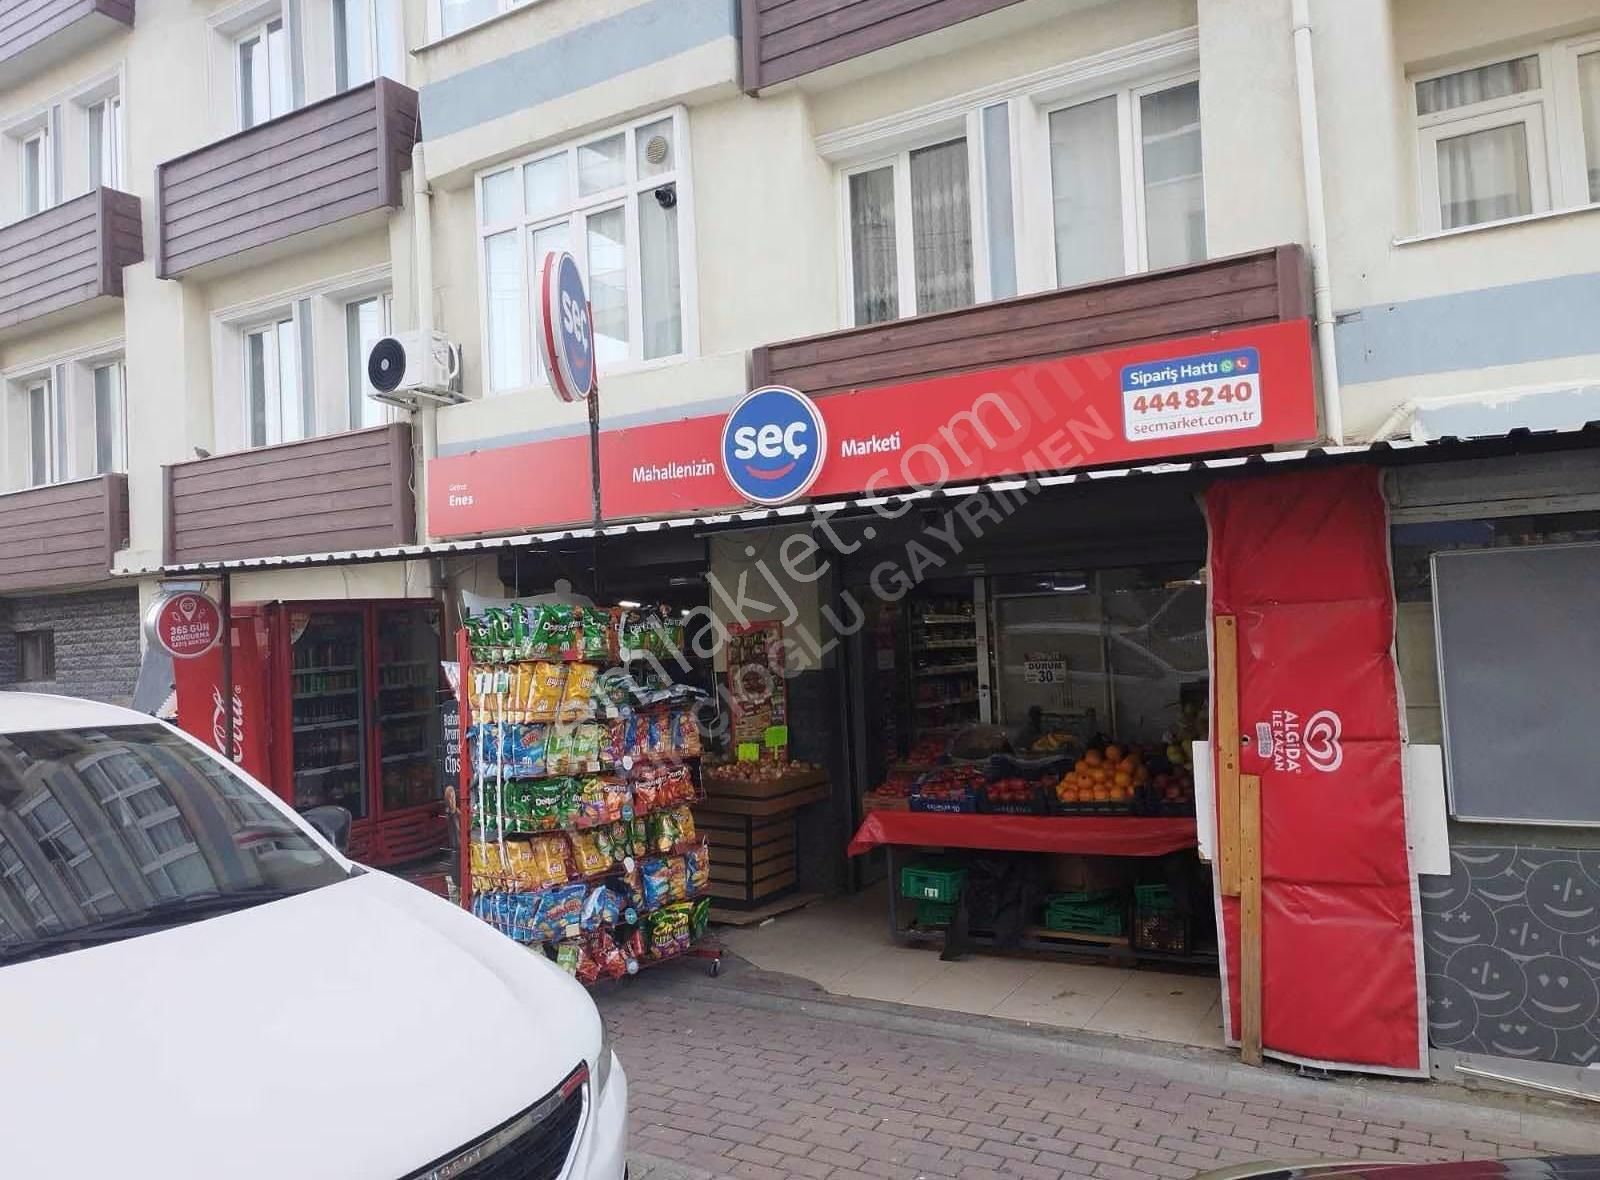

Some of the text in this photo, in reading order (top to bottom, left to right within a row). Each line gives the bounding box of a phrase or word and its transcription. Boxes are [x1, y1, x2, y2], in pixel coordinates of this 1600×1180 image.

[1130, 362, 1218, 387] Sipariş Hattı
[1133, 410, 1254, 435] secmarket.com.tr
[734, 421, 808, 460] seç
[841, 431, 901, 458] Marketi
[632, 460, 715, 483] Mahallenizin
[449, 495, 474, 508] Enes
[170, 626, 188, 637] 365
[1039, 670, 1054, 682] 30
[1273, 730, 1285, 771] KAZAN
